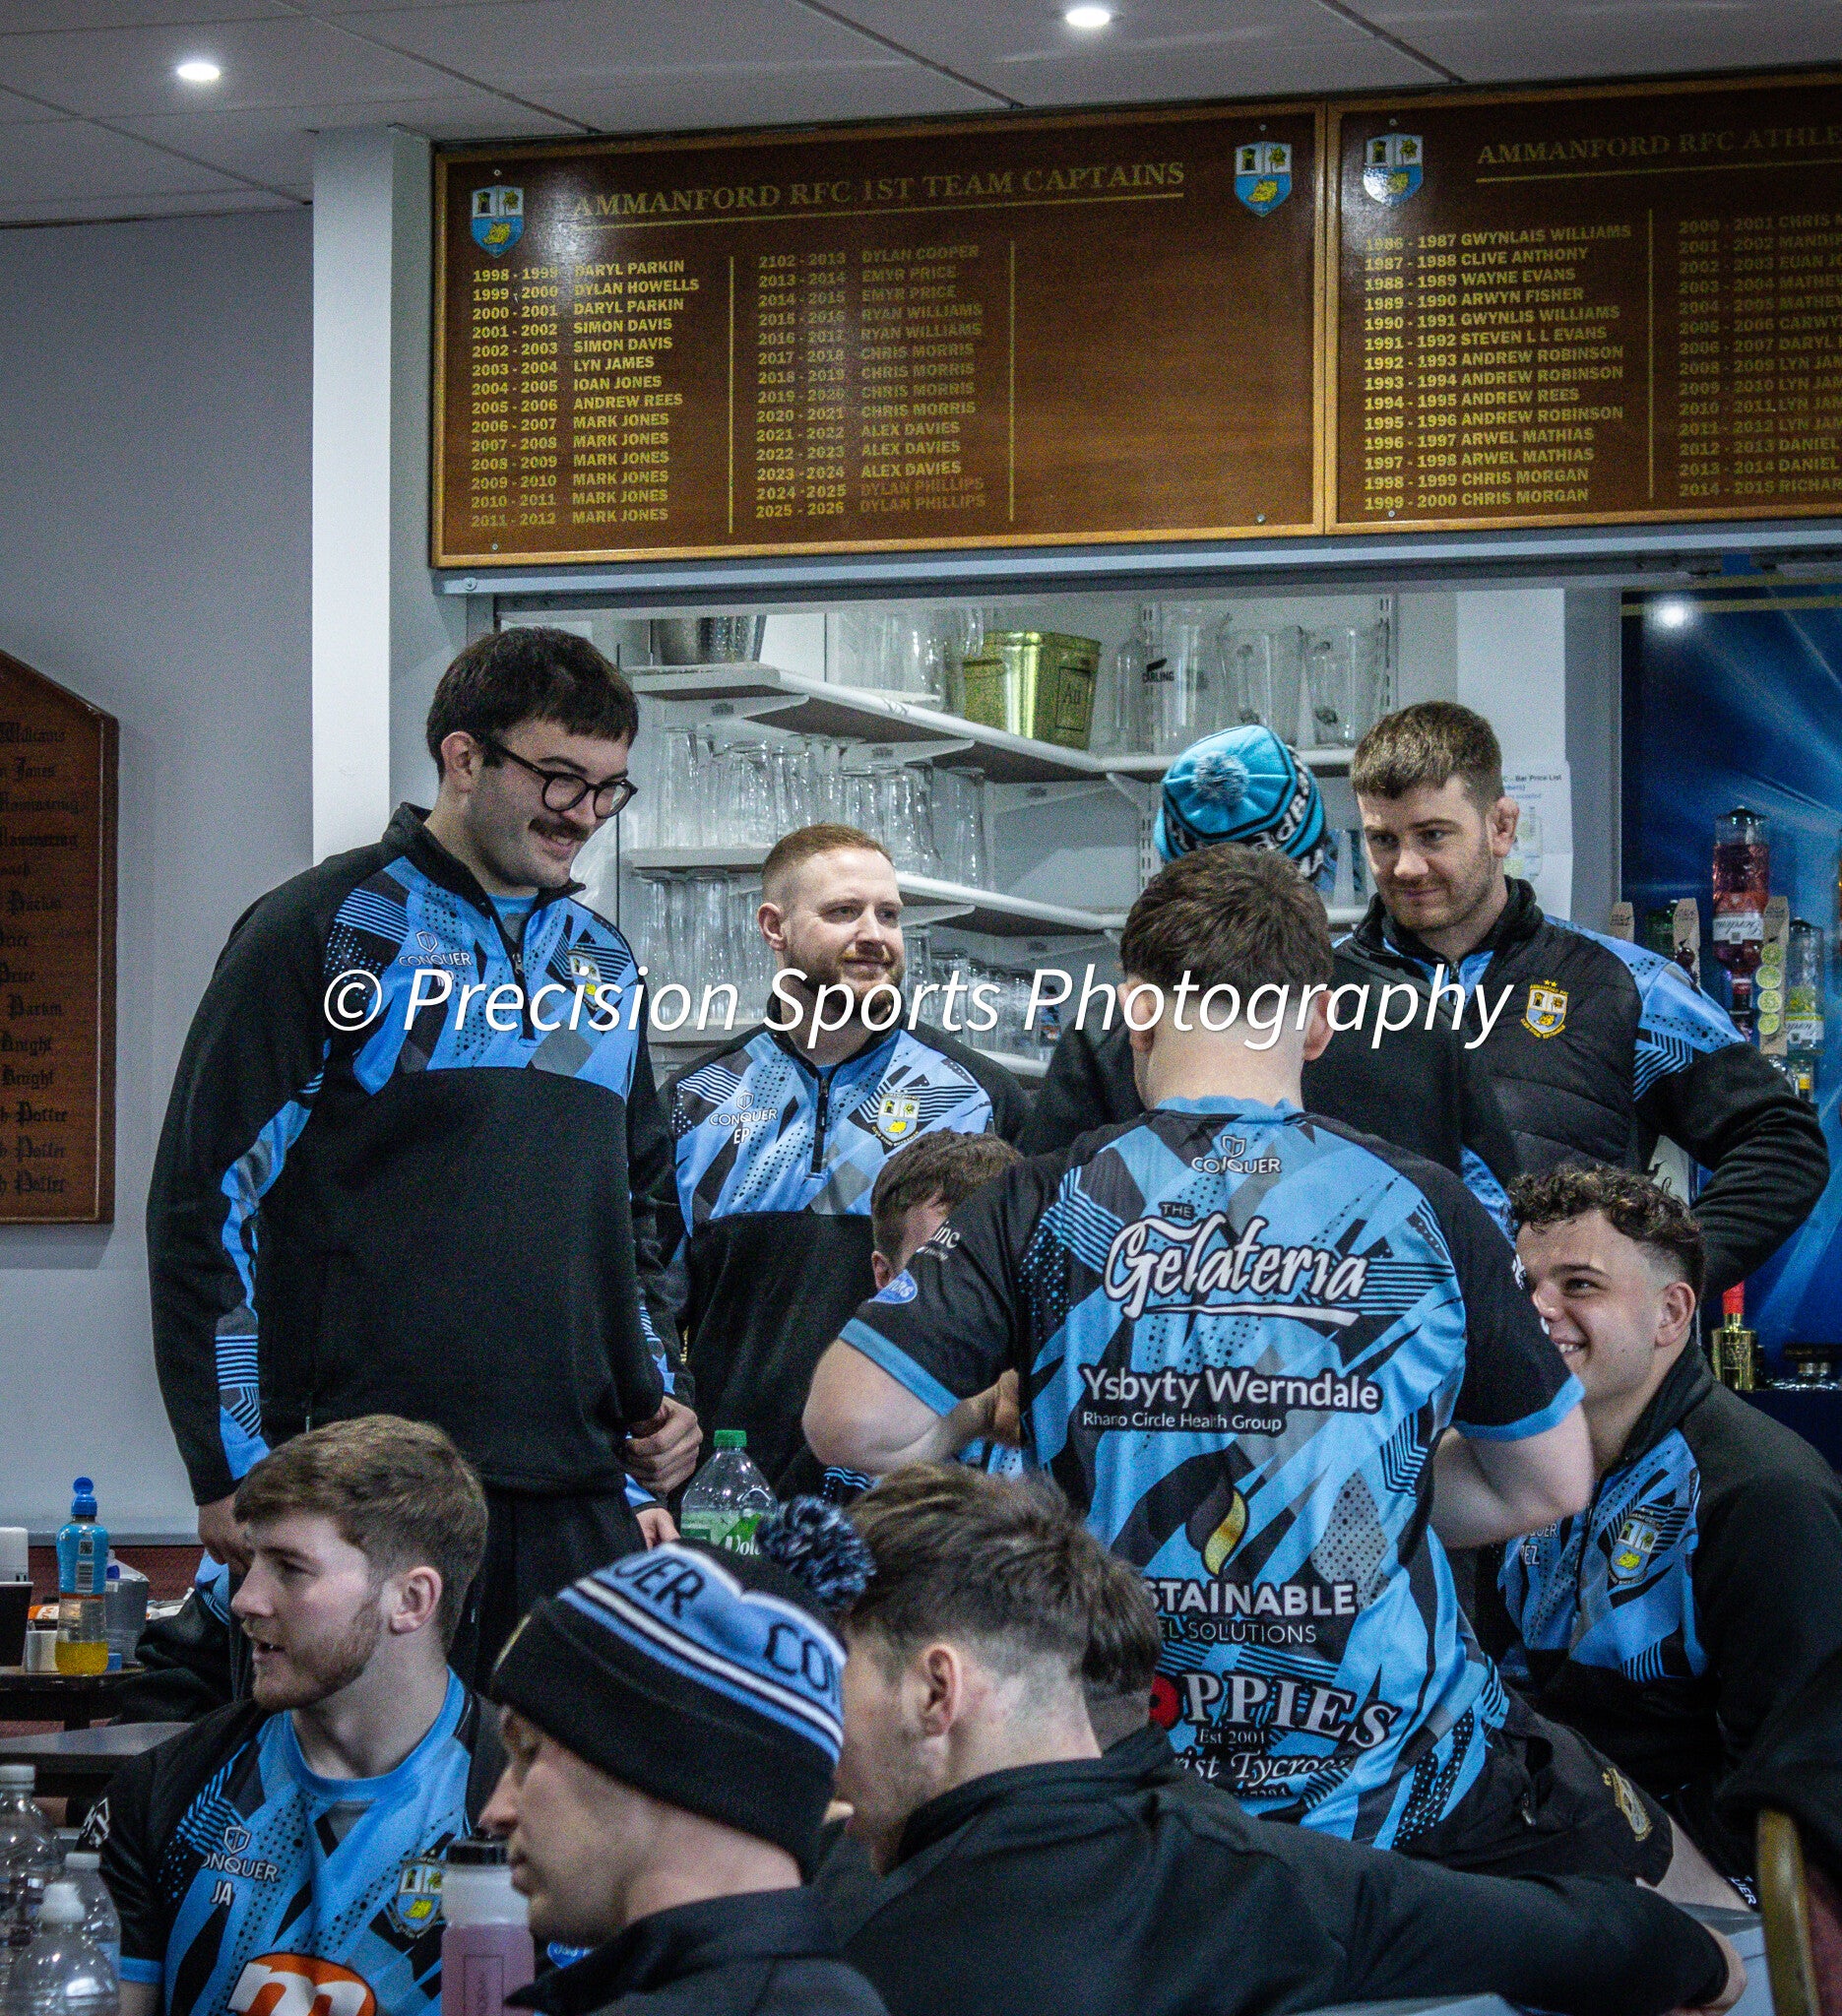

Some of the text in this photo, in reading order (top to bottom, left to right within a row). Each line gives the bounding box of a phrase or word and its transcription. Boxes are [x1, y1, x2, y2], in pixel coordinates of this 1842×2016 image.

[1477, 136, 1670, 166] AMMANFORD
[1680, 130, 1735, 155] RFC
[574, 162, 1184, 216] AMMANFORD RFC 1ST TEAM CAPTAINS
[1365, 246, 1588, 271] 1987 1988 CLIVE ANTHONY
[474, 269, 508, 282] 1998
[628, 260, 683, 274] PARKIN
[474, 287, 508, 300] 1999
[628, 279, 699, 293] HOWELLS
[1365, 286, 1583, 311] 1989 1990 ARWYN FISHER
[473, 298, 683, 320] 2000 2001 DARYL PARKIN
[1365, 305, 1620, 331] 1990 1991 GWYNLIS WILLIAMS
[472, 318, 671, 339] 2001 2002 SIMON DAVIS
[472, 337, 672, 357] 2002 2003 SIMON DAVIS
[472, 355, 654, 376] 2003 2004 LYN JAMES
[1365, 345, 1622, 371] 1992 1993 ANDREW ROBINSON
[472, 375, 662, 396] 2004 2005 IOAN JONES
[1365, 364, 1622, 391] 1993 1994 ANDREW ROBINSON
[472, 393, 682, 414] 2005 2006 ANDREW REES
[1365, 387, 1578, 410] 1994 1995 ANDREW REES
[861, 404, 907, 418] CHRIS
[914, 401, 976, 416] MORRIS
[472, 412, 668, 433] 2006 2007 MARK JONES
[861, 423, 899, 437] ALEX
[905, 420, 960, 435] DAVIES
[472, 431, 668, 453] 2007 2008 MARK JONES
[472, 450, 669, 472] 2008 2009 MARK JONES
[861, 463, 901, 477] ALEX
[906, 461, 961, 475] DAVIES
[472, 476, 507, 490] 2009
[573, 472, 617, 485] MARK
[621, 470, 668, 483] JONES
[1365, 467, 1588, 490] 1998 1999 CHRIS MORGAN
[572, 490, 616, 505] MARK
[620, 488, 667, 502] JONES
[399, 951, 473, 967] CONQUER
[710, 1107, 778, 1126] CONQUER
[733, 1128, 750, 1145] EP
[1162, 1203, 1191, 1218] THE
[1106, 1214, 1366, 1318] Gelateria
[1084, 1367, 1378, 1410] Ysbyty Werndale
[1132, 1412, 1175, 1427] Circle
[1232, 1415, 1282, 1432] Group
[1189, 1623, 1317, 1644] SOLUTIONS
[1198, 1728, 1266, 1744] Est 2001
[211, 1880, 233, 1907] JA
